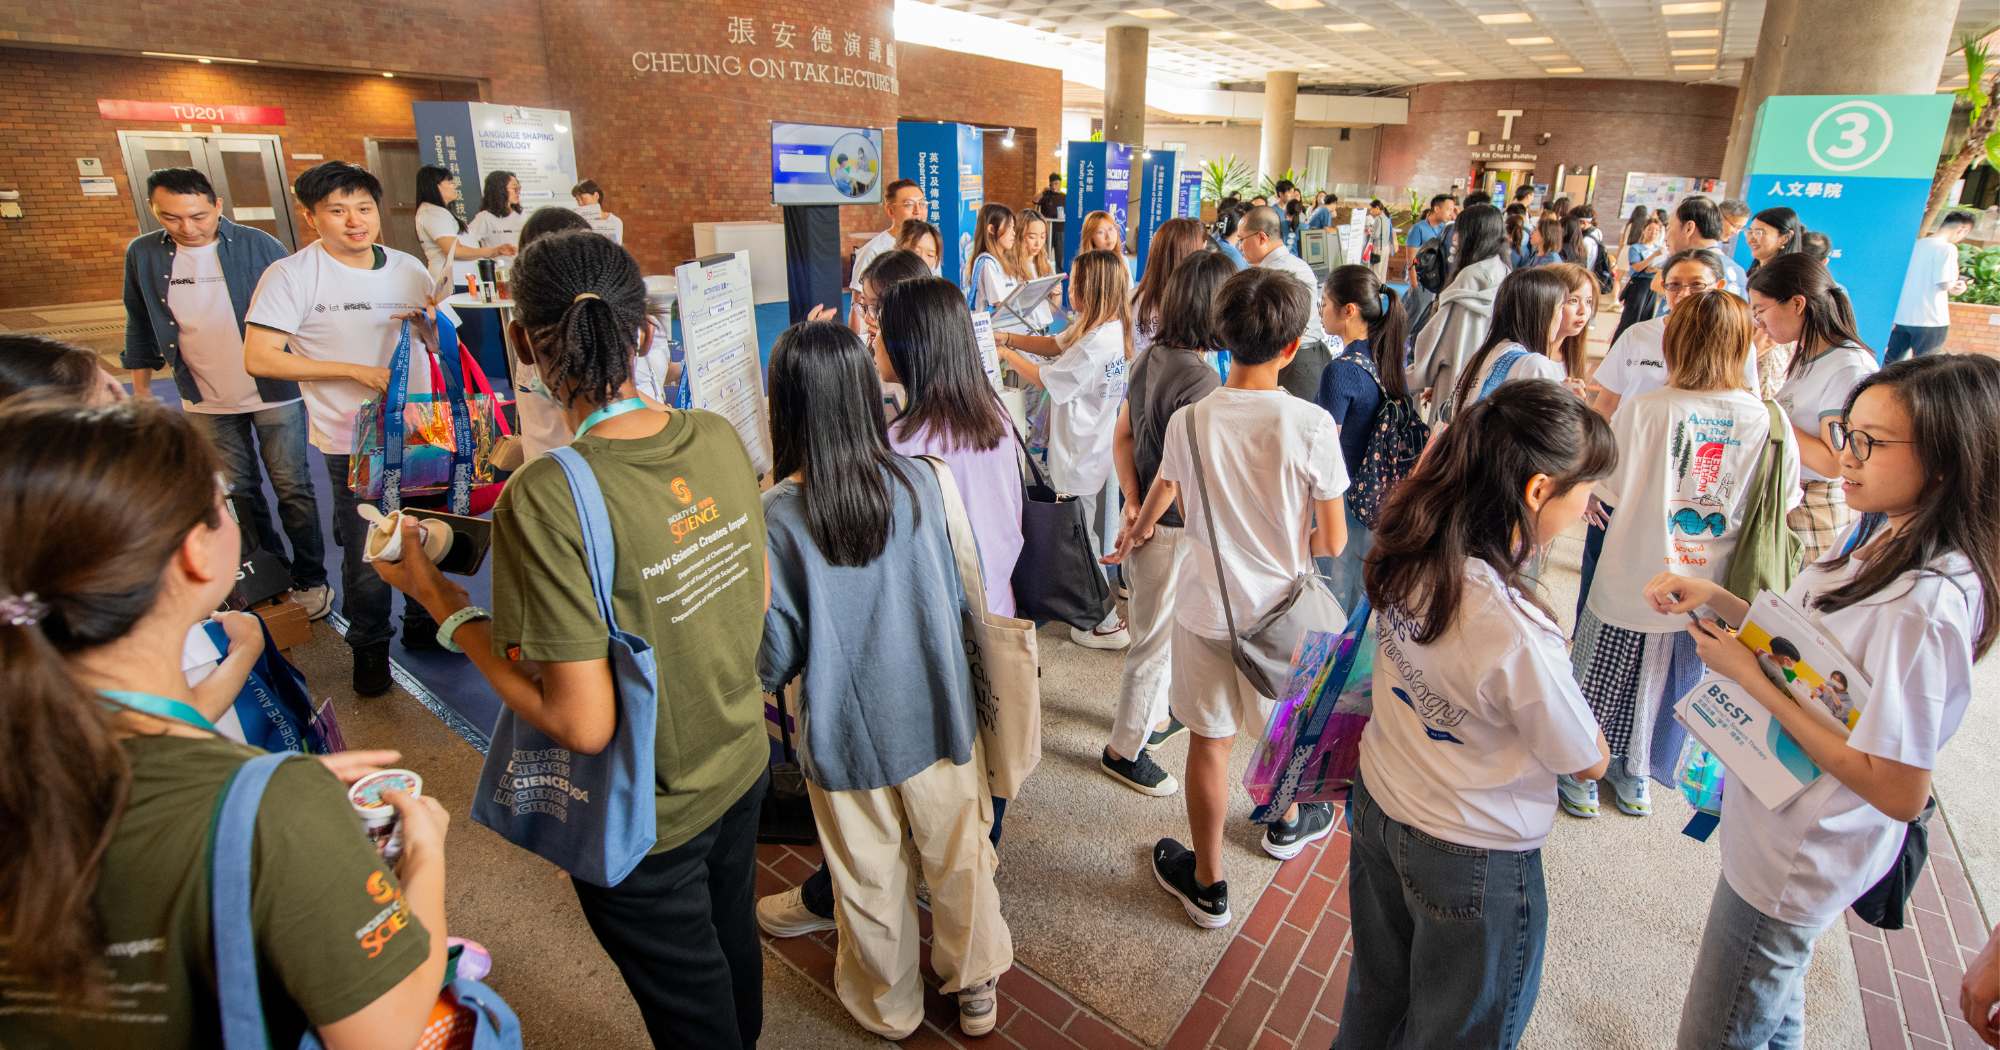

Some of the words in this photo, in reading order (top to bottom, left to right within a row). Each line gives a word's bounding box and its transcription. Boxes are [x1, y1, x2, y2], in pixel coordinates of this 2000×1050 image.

[727, 16, 896, 68] 張安德演講廳
[632, 51, 742, 76] CHEUNG
[749, 57, 785, 79] ON
[790, 61, 830, 84] TAK
[833, 66, 890, 92] LECTURE
[170, 105, 225, 121] TU201
[1497, 109, 1523, 140] T
[434, 135, 446, 167] Depart
[478, 130, 521, 140] LANGUAGE
[522, 132, 554, 141] SHAPING
[480, 139, 531, 150] TECHNOLOGY
[1826, 112, 1870, 159] 3
[1471, 151, 1481, 159] Yip
[1512, 153, 1537, 161] Building
[918, 152, 927, 199] Departme
[1086, 160, 1094, 192] 人文學院
[1767, 181, 1844, 199] 人文學院
[398, 364, 408, 392] SCIENCE
[1105, 355, 1125, 372] LANG
[1489, 354, 1511, 385] DEPARTM
[395, 392, 405, 425] LANGUAGE
[1687, 412, 1734, 427] Across
[1695, 431, 1741, 447] Decades
[1708, 427, 1727, 436] The
[1692, 458, 1703, 476] THE
[1697, 459, 1711, 492] NORTH
[1708, 458, 1722, 484] FACE
[667, 508, 690, 526] FACULTY
[689, 504, 698, 514] OF
[670, 504, 721, 545] SCIENCE
[642, 557, 671, 580] PolyU
[671, 542, 699, 566] Science
[698, 525, 729, 549] Creates
[727, 512, 749, 532] Impact
[677, 557, 705, 580] Department
[704, 554, 711, 563] of
[710, 542, 734, 559] Chemistry
[1673, 542, 1705, 554] Beyond
[1679, 555, 1707, 566] Map
[656, 583, 690, 604] Department
[689, 577, 696, 585] of
[695, 569, 707, 581] Food
[706, 558, 724, 576] Science
[723, 554, 734, 564] and
[732, 542, 752, 558] Nutrition
[681, 582, 708, 606] Department
[707, 578, 713, 587] of
[711, 571, 721, 584] Life
[720, 562, 739, 579] Sciences
[671, 600, 702, 624] Department
[701, 595, 707, 604] of
[706, 586, 722, 602] Physics
[721, 579, 731, 590] and
[730, 567, 749, 584] Materials
[1707, 684, 1753, 726] BScST
[267, 707, 299, 752] SCIENCE
[1701, 693, 1712, 705] BSc
[1711, 703, 1726, 720] (Hons)
[1729, 721, 1749, 742] Speech
[1748, 739, 1768, 761] Therapy
[1197, 897, 1213, 908] PUMA
[361, 910, 409, 959] SCIE
